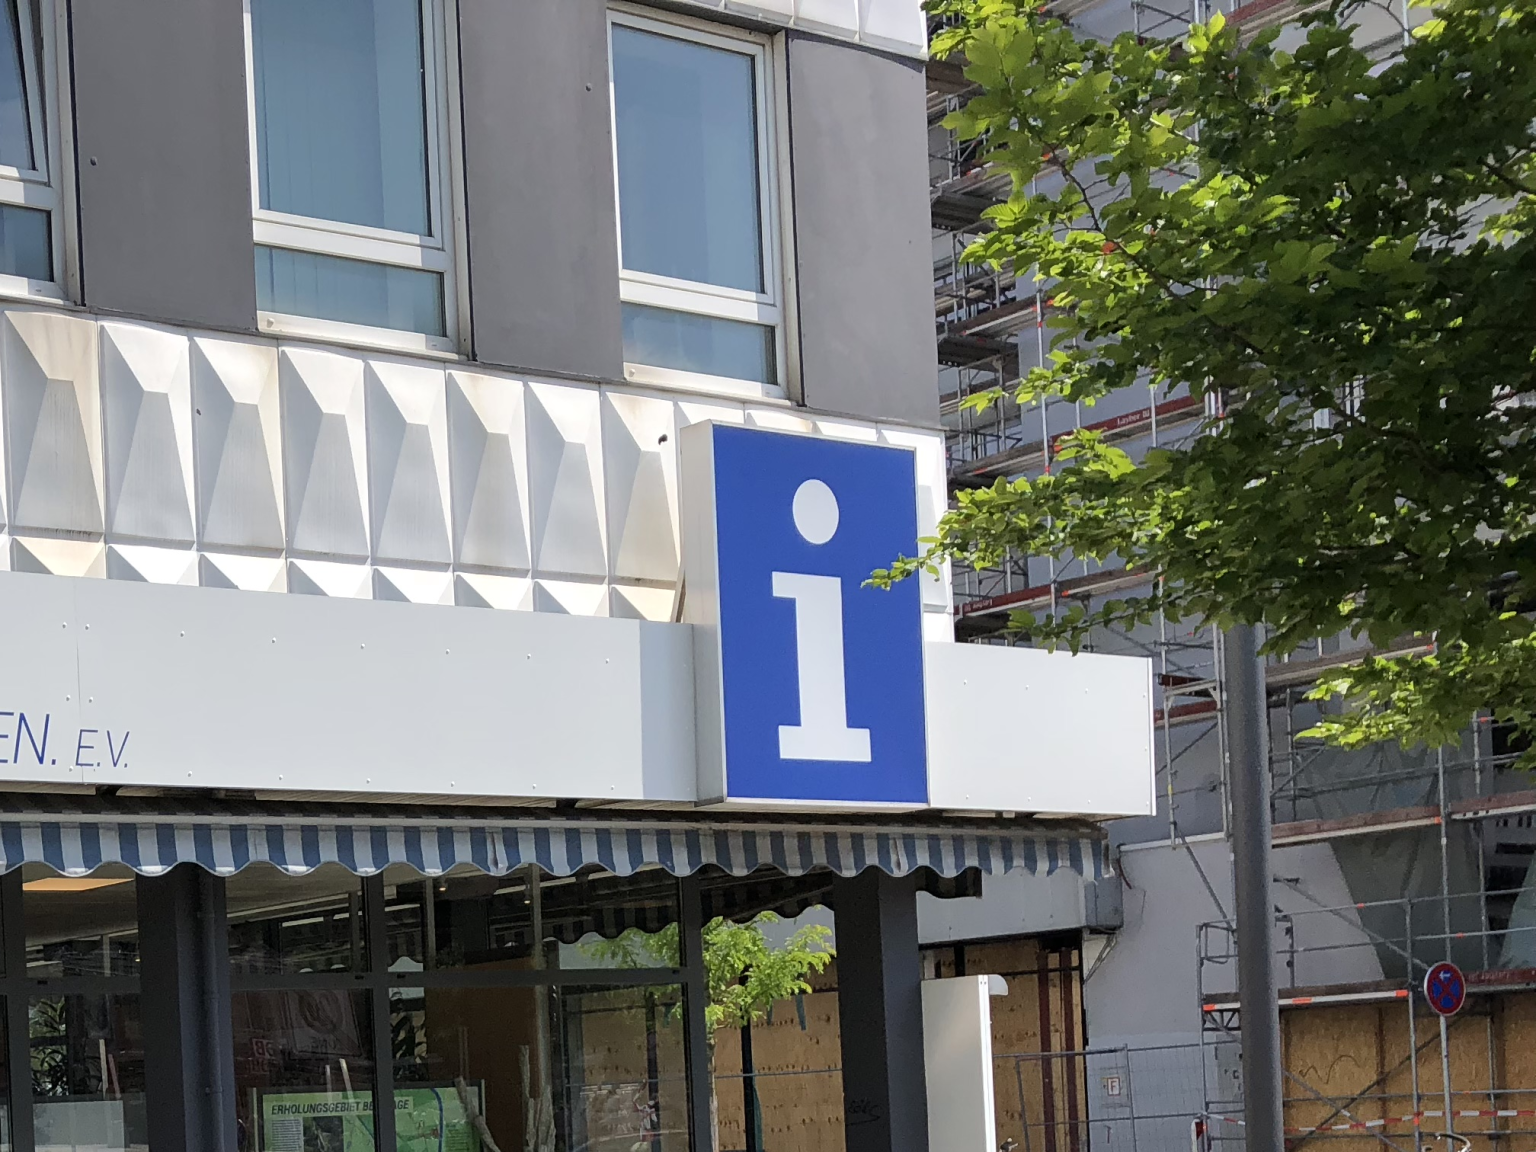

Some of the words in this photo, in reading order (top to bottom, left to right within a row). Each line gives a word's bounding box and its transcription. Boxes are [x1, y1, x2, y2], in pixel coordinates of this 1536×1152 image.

[771, 478, 873, 763] i
[74, 728, 131, 769] E.V.
[271, 1102, 360, 1115] ERHOLUNGSGEBIET
